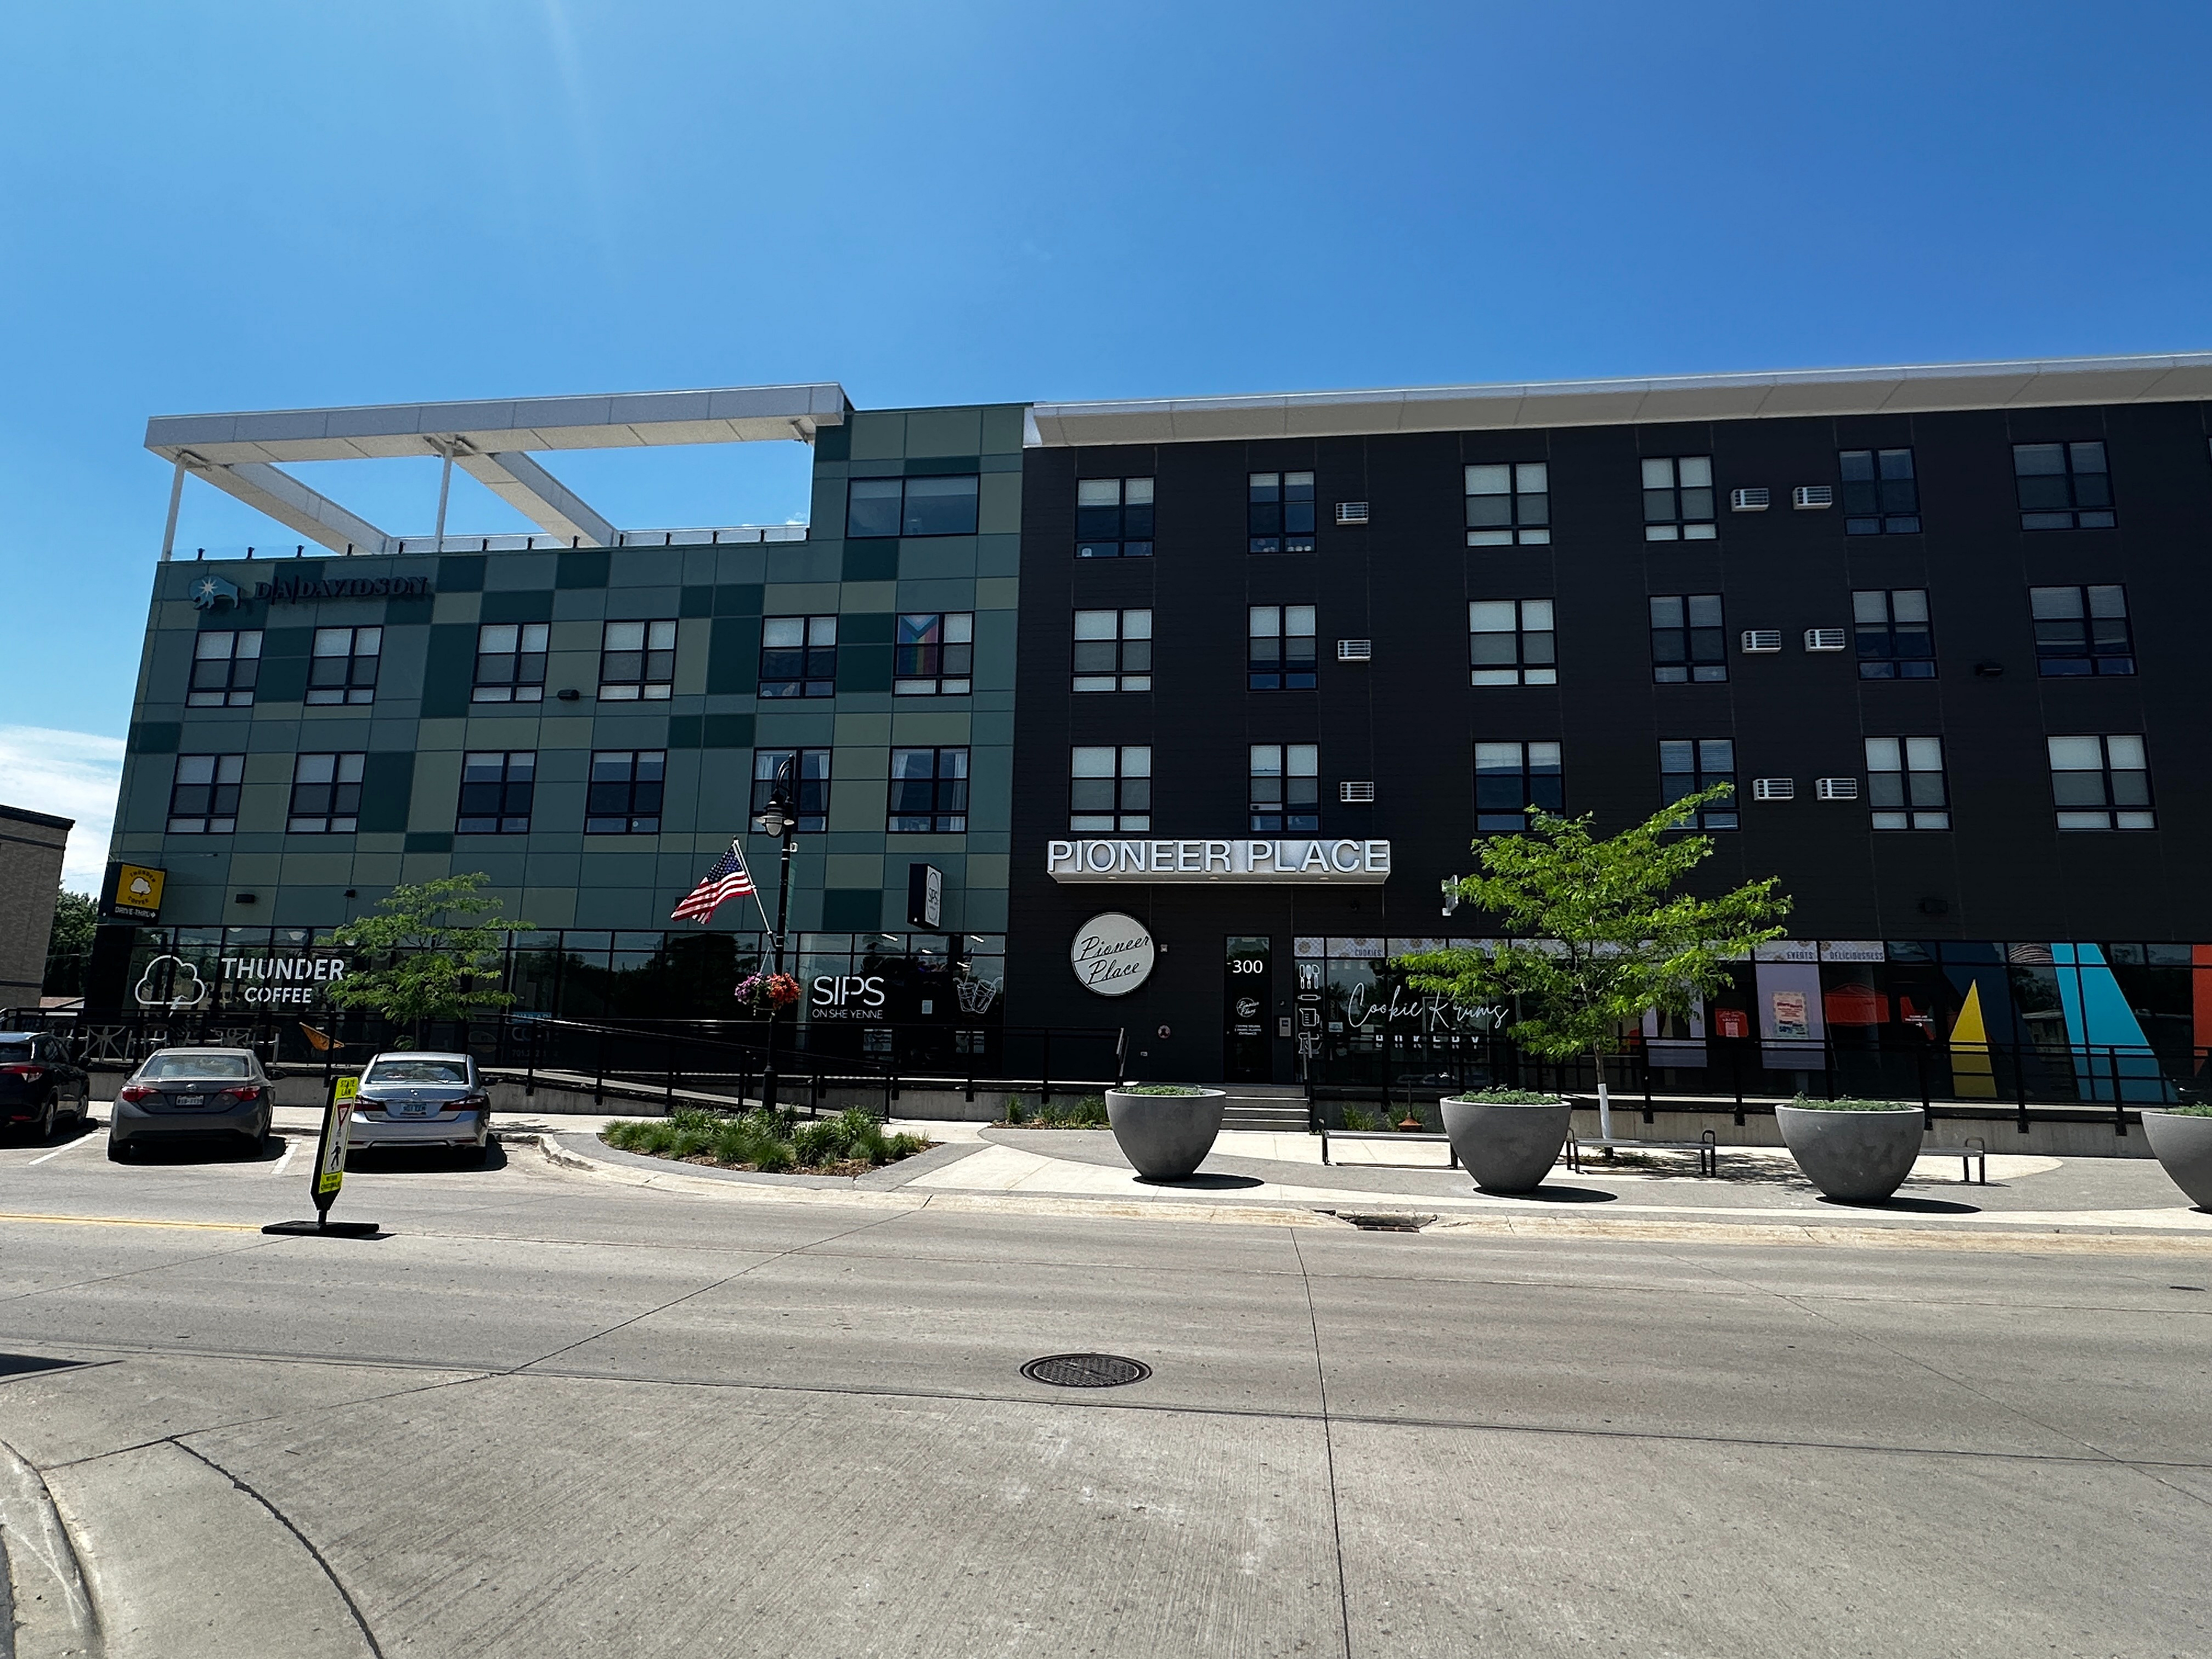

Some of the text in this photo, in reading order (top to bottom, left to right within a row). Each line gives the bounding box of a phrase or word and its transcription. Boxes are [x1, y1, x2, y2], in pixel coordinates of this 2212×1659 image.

[1048, 839, 1389, 871] PIONEER PLACE
[928, 887, 939, 905] SIPS
[1074, 935, 1149, 962] Pioneer
[1787, 951, 1813, 960] EVENTS
[221, 958, 345, 980] THUNDER
[1086, 959, 1140, 985] Place
[1232, 960, 1263, 973] 300
[244, 987, 313, 1003] COFFEE
[812, 975, 885, 1006] SIPS
[812, 1009, 827, 1018] ON
[1348, 982, 1423, 1028] Cookie
[1428, 988, 1509, 1032] Krums
